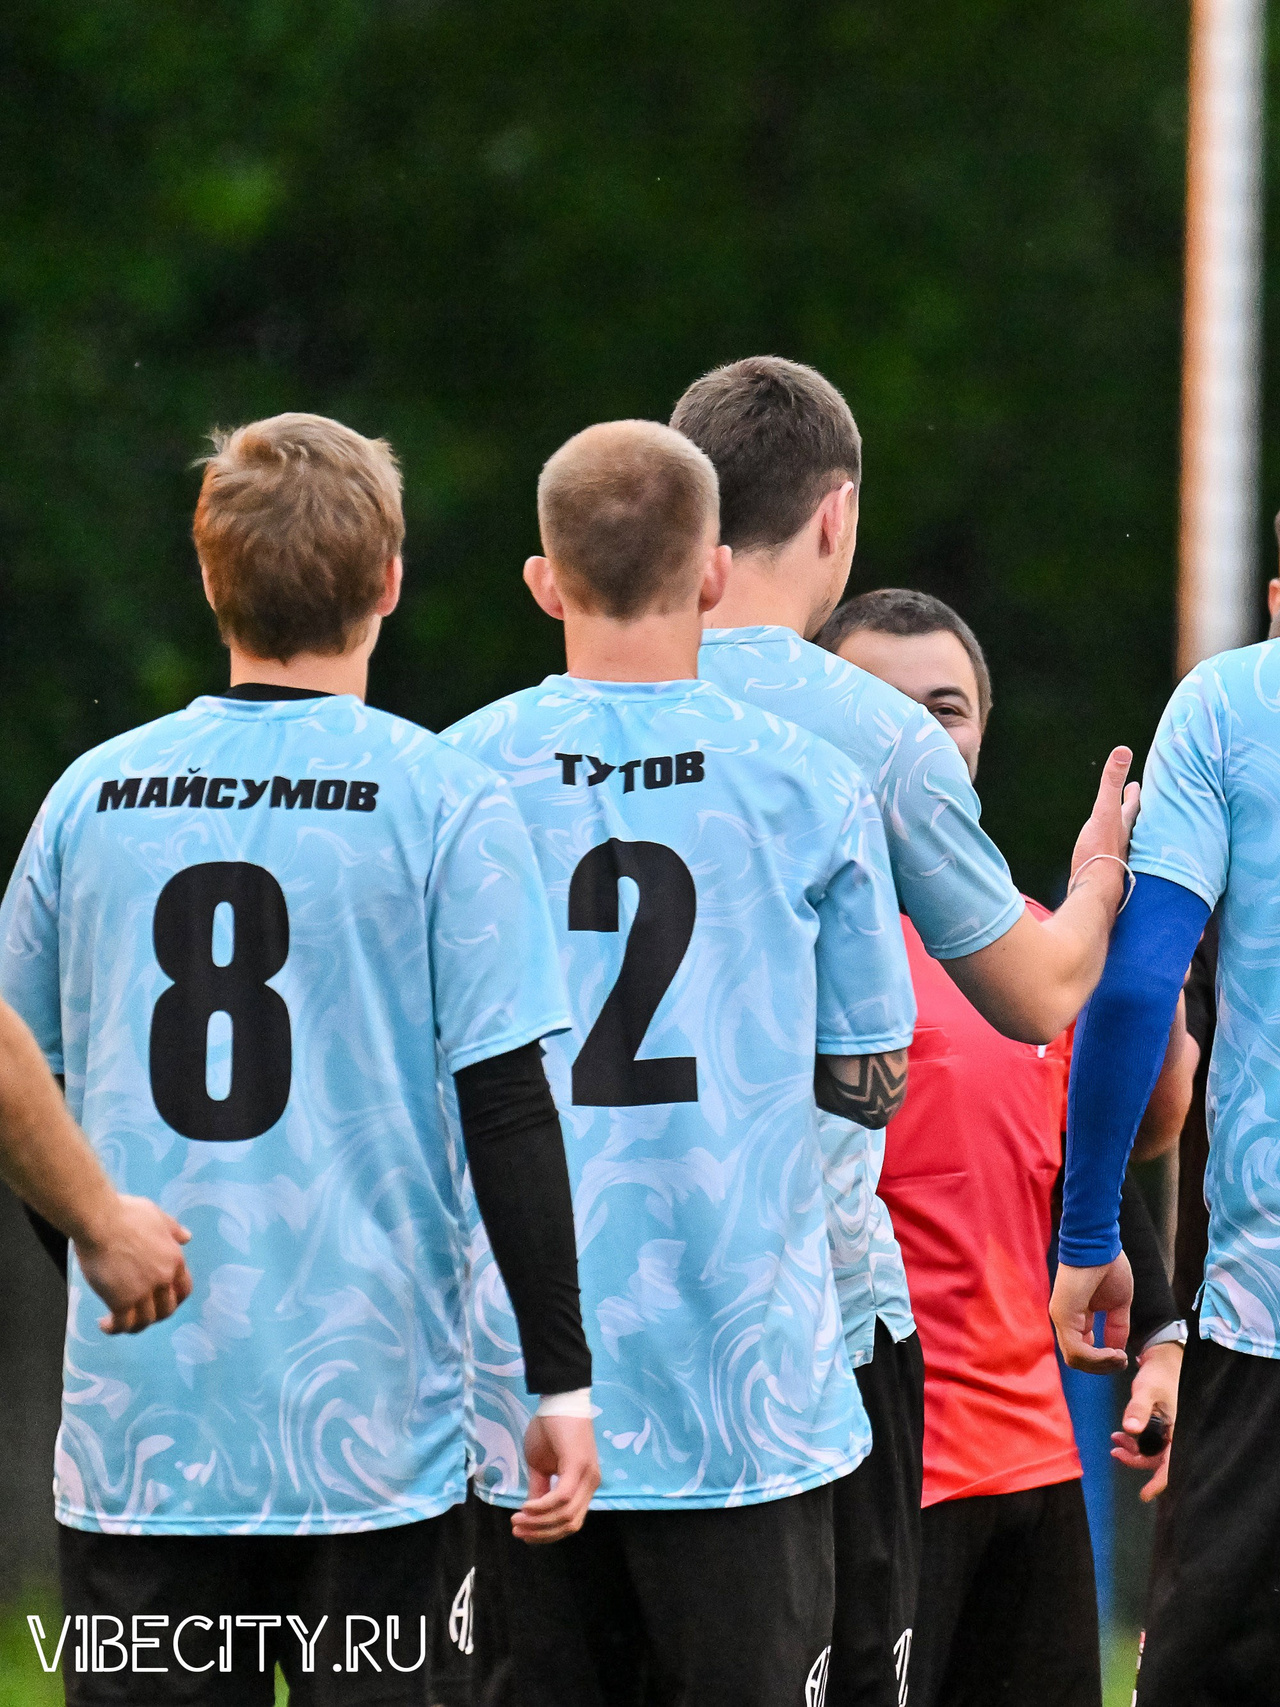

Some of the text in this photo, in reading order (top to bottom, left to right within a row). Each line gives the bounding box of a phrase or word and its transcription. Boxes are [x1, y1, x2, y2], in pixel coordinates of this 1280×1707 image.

[96, 768, 380, 813] МАЙСУМОВ
[554, 750, 705, 794] ТУТОВ
[149, 861, 292, 1142] 8
[567, 837, 699, 1107] 2
